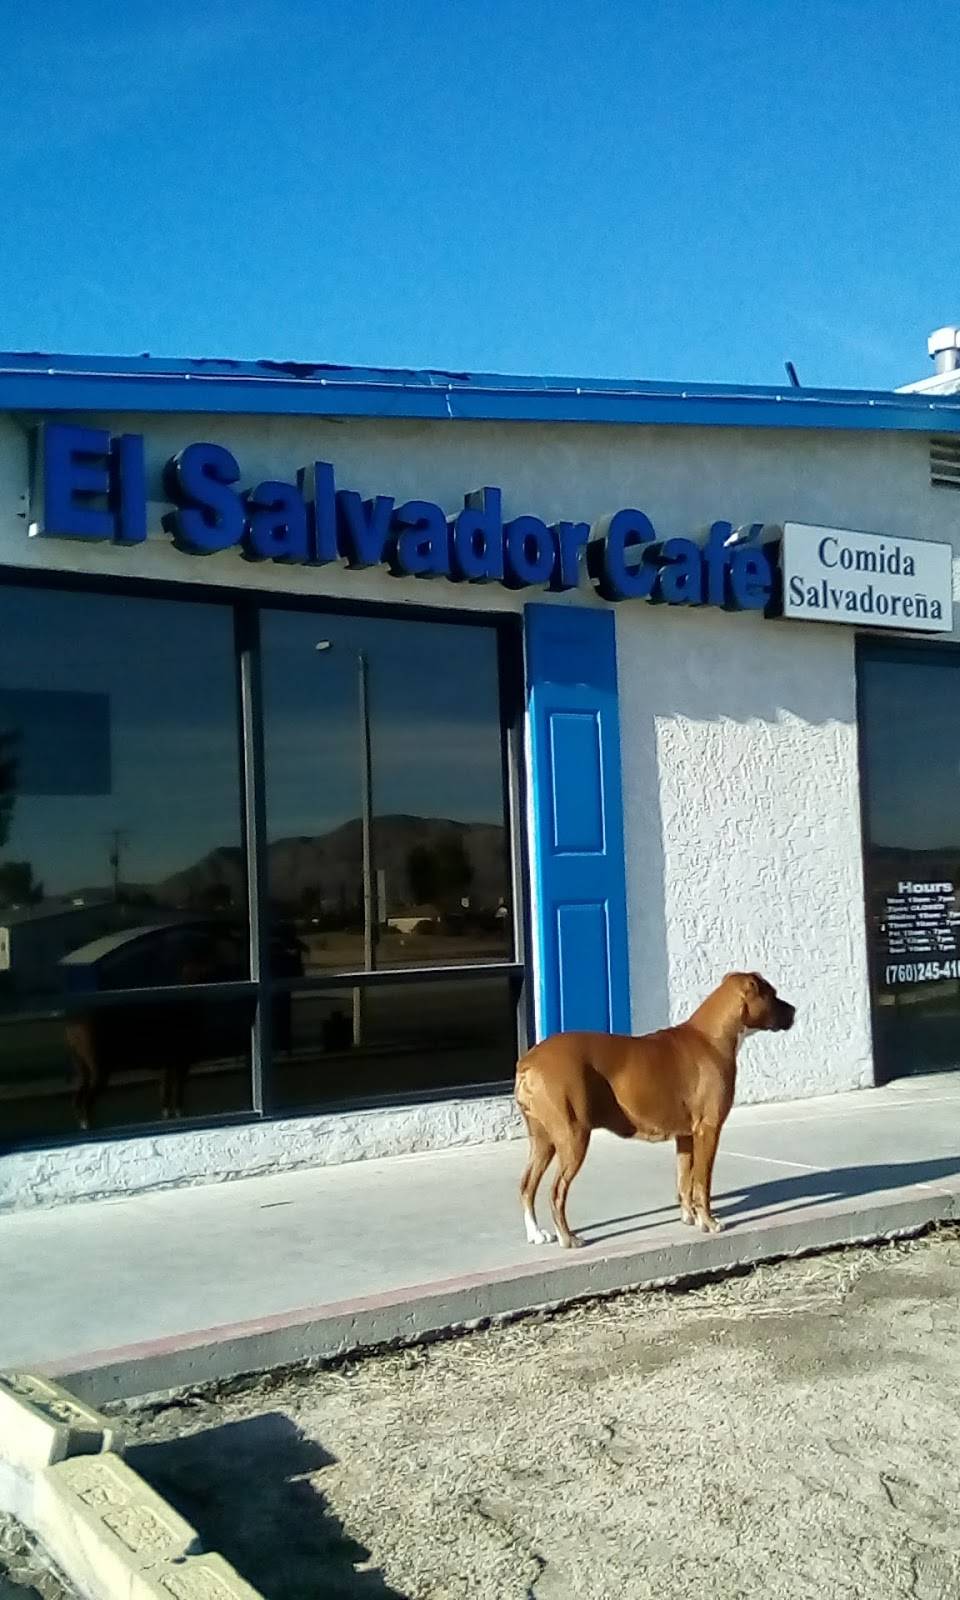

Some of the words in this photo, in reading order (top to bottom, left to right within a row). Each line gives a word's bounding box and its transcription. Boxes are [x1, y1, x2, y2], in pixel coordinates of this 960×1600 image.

[38, 424, 147, 546] El
[164, 442, 590, 592] Salvador
[596, 508, 773, 611] Café
[818, 536, 916, 577] Comida
[789, 575, 943, 621] Salvadoreña
[898, 881, 954, 894] Hours
